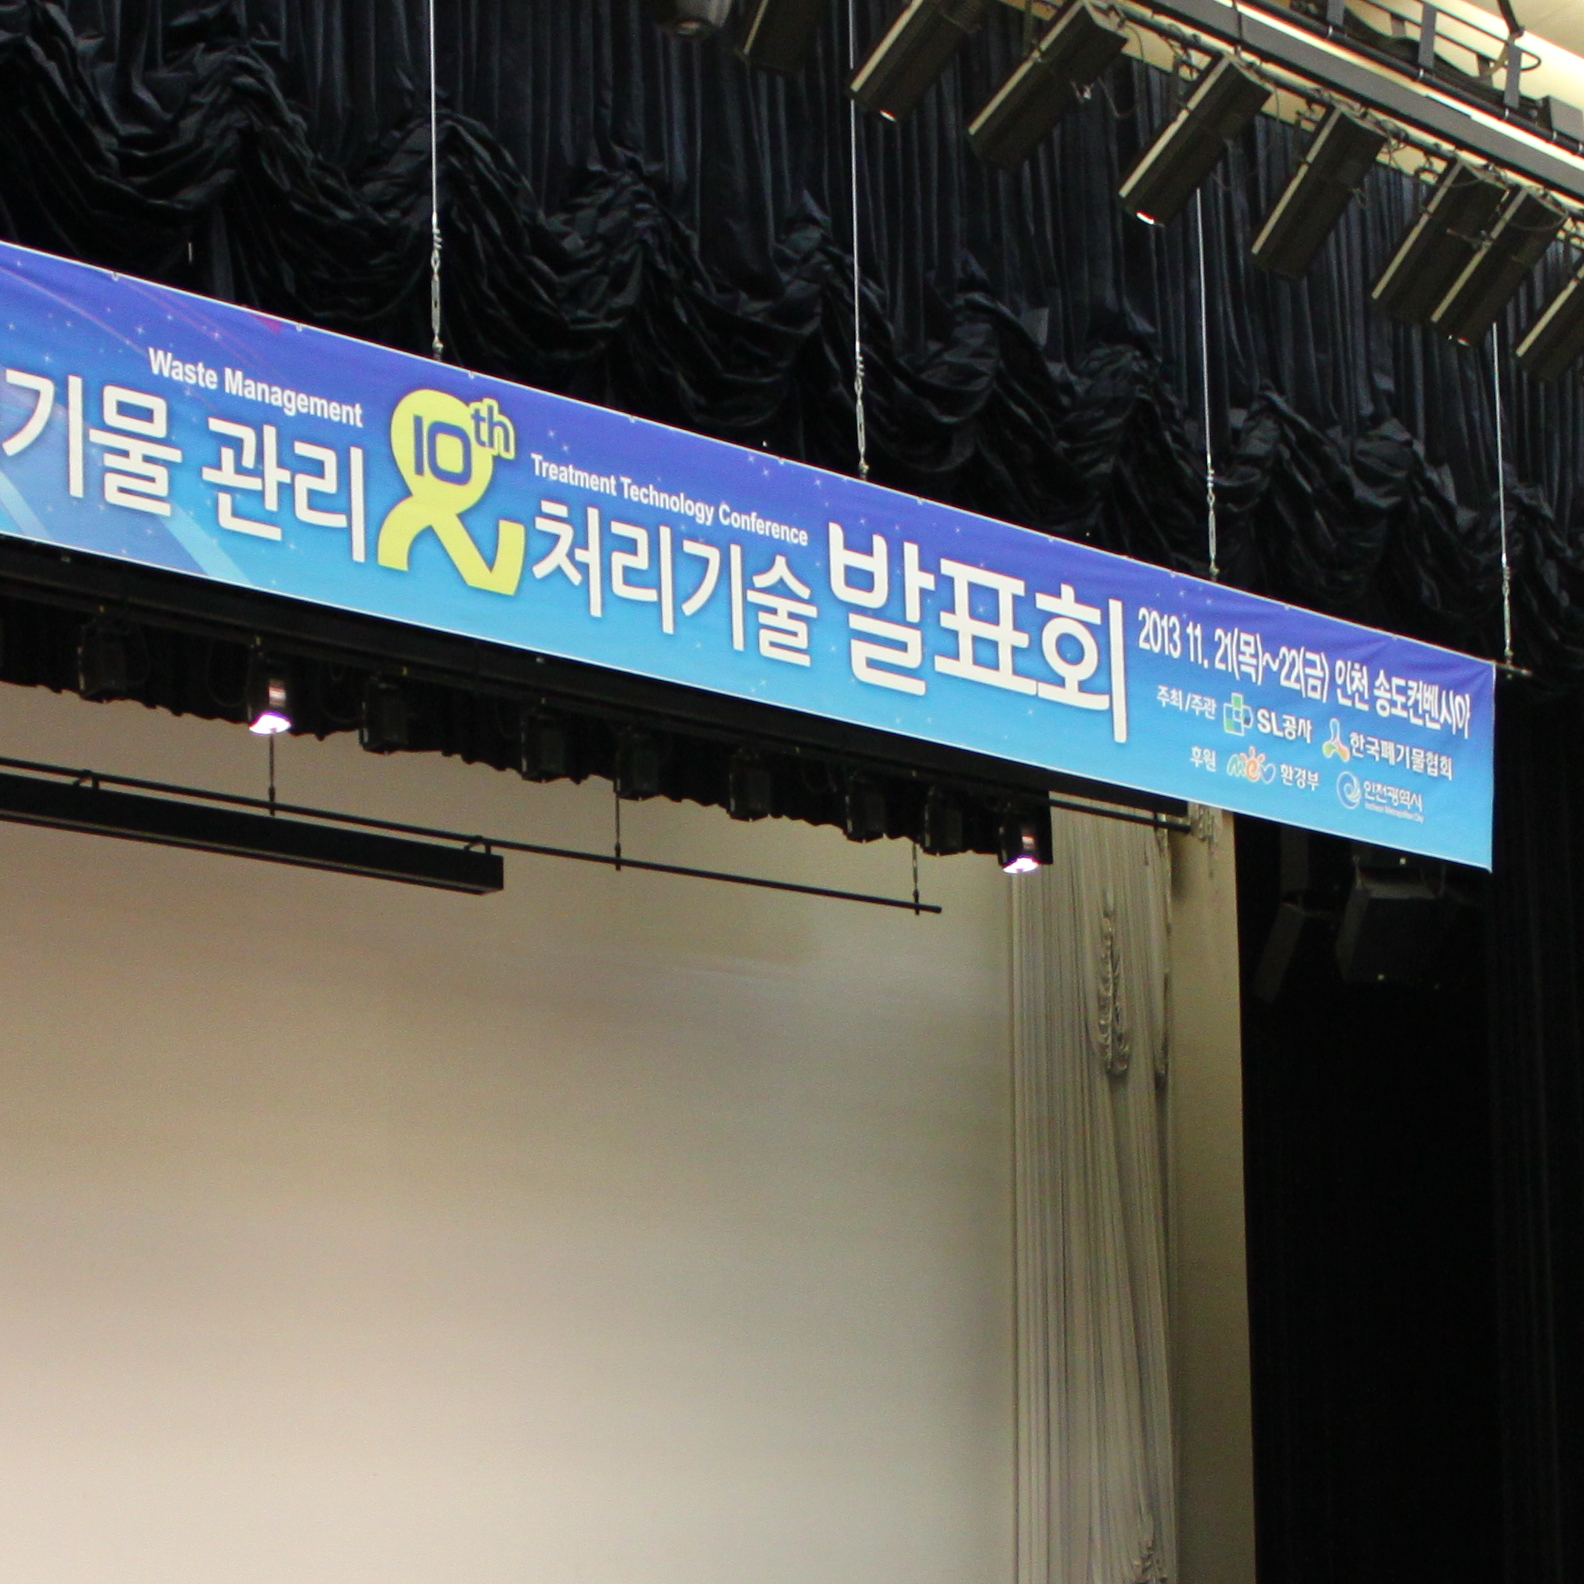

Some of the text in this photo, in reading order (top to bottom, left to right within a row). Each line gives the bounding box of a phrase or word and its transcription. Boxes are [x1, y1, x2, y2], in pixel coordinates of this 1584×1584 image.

[148, 347, 364, 428] Waste Management
[413, 397, 515, 486] 10th
[530, 453, 809, 547] Treatment Technology Conference
[201, 417, 367, 564] 관리
[531, 499, 818, 668] 처리기술
[827, 521, 1128, 744] 발표회
[1138, 606, 1181, 660] 2013
[1186, 621, 1210, 670] 11.
[1334, 659, 1370, 712] 인천
[1373, 669, 1472, 740] 송도컨벤시아
[1256, 707, 1314, 745] SL공사
[1349, 731, 1454, 781] 한국폐기물협회
[1190, 745, 1217, 773] 후원
[1280, 763, 1320, 792] 환경부
[1363, 780, 1424, 812] 인천광역시
